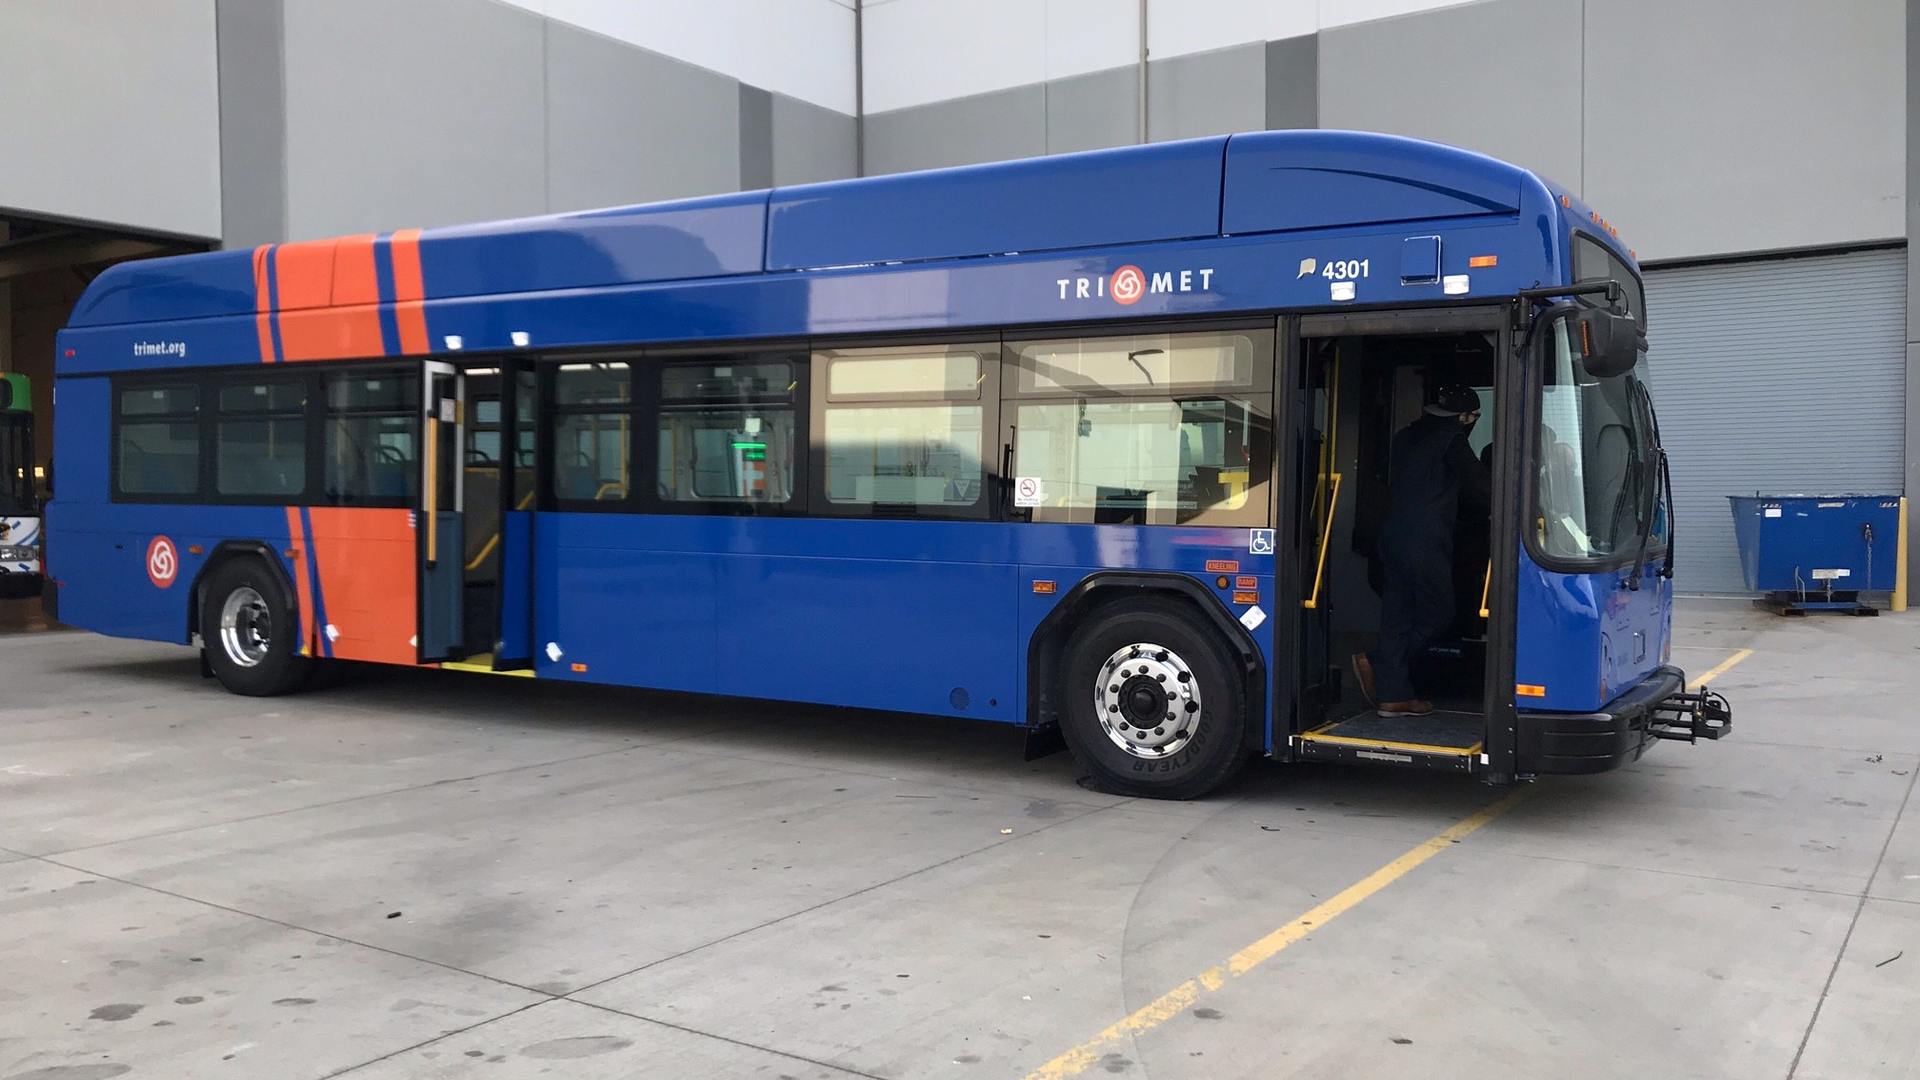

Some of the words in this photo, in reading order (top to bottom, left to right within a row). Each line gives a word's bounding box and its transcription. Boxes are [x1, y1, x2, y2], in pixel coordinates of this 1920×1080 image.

[1322, 259, 1369, 280] 4301
[134, 340, 186, 358] trimet.org
[1208, 562, 1237, 571] KNEELING
